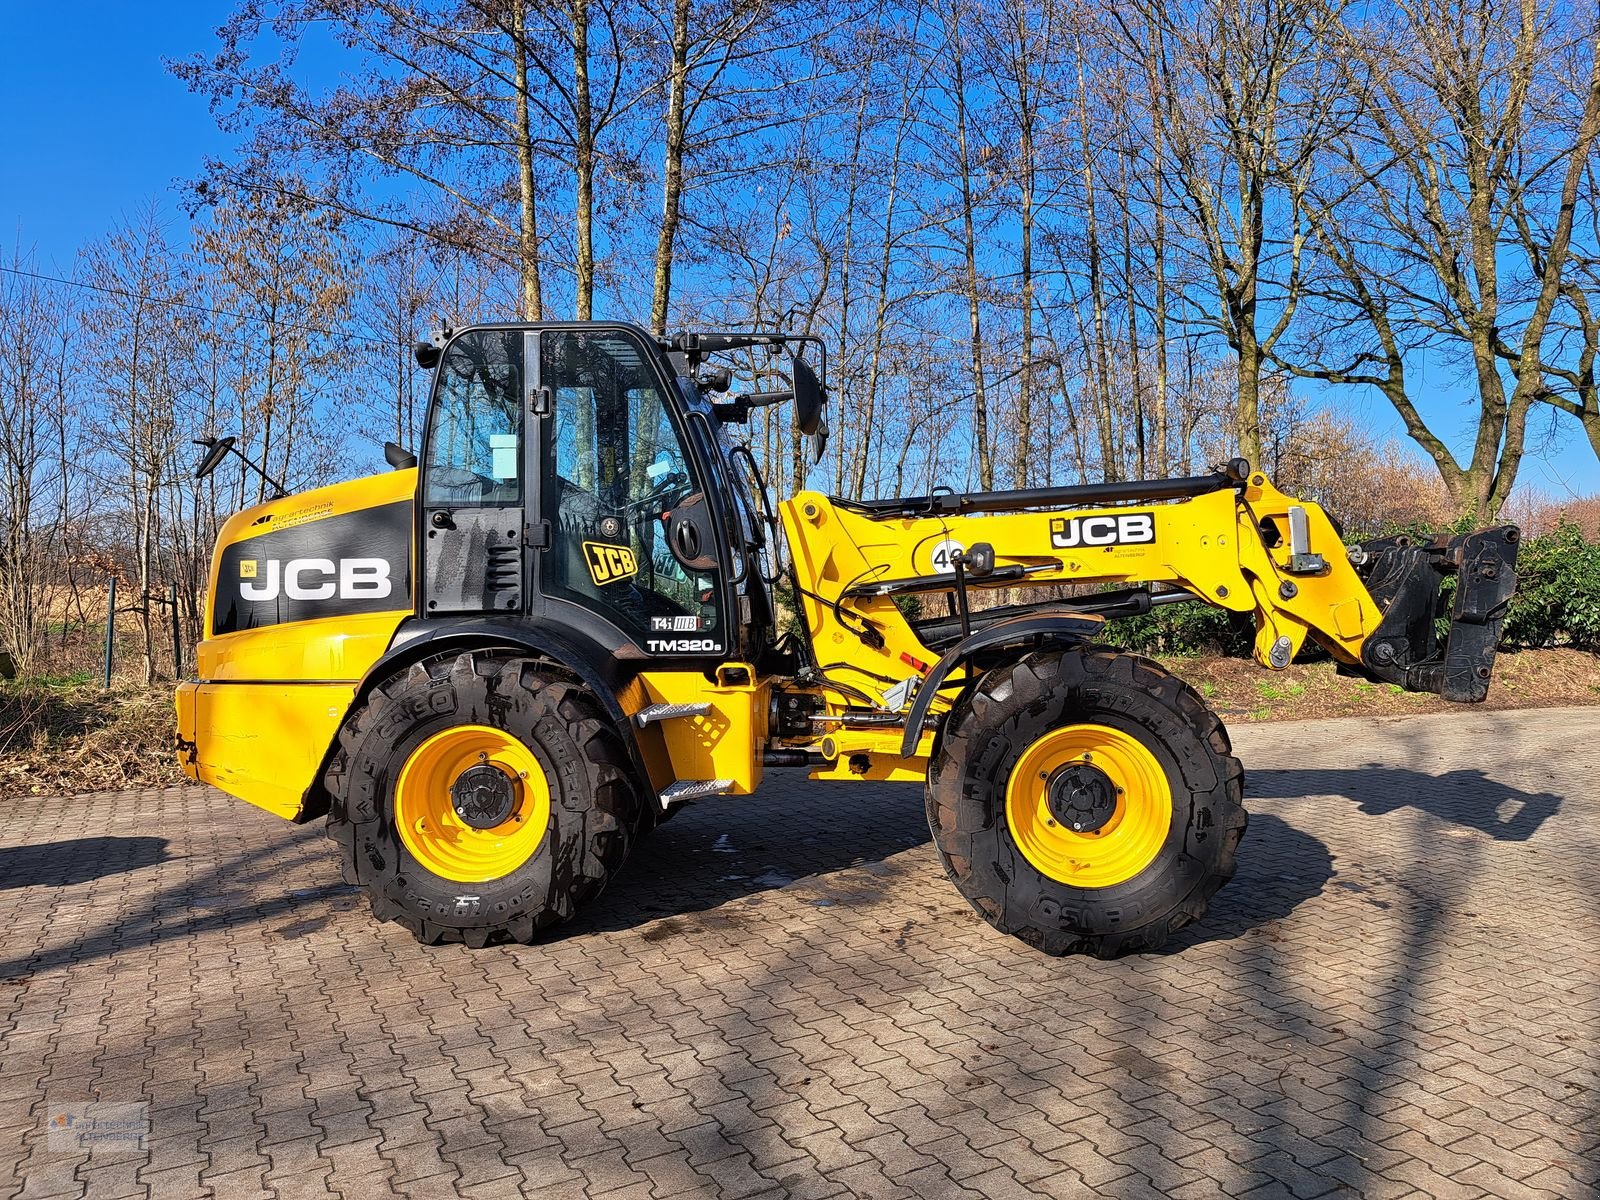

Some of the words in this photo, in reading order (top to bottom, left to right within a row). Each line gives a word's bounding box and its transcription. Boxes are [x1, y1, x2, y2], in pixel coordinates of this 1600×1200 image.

[1053, 515, 1153, 547] JCB
[240, 558, 392, 600] JCB
[593, 546, 634, 581] JCB
[653, 617, 673, 630] T4i
